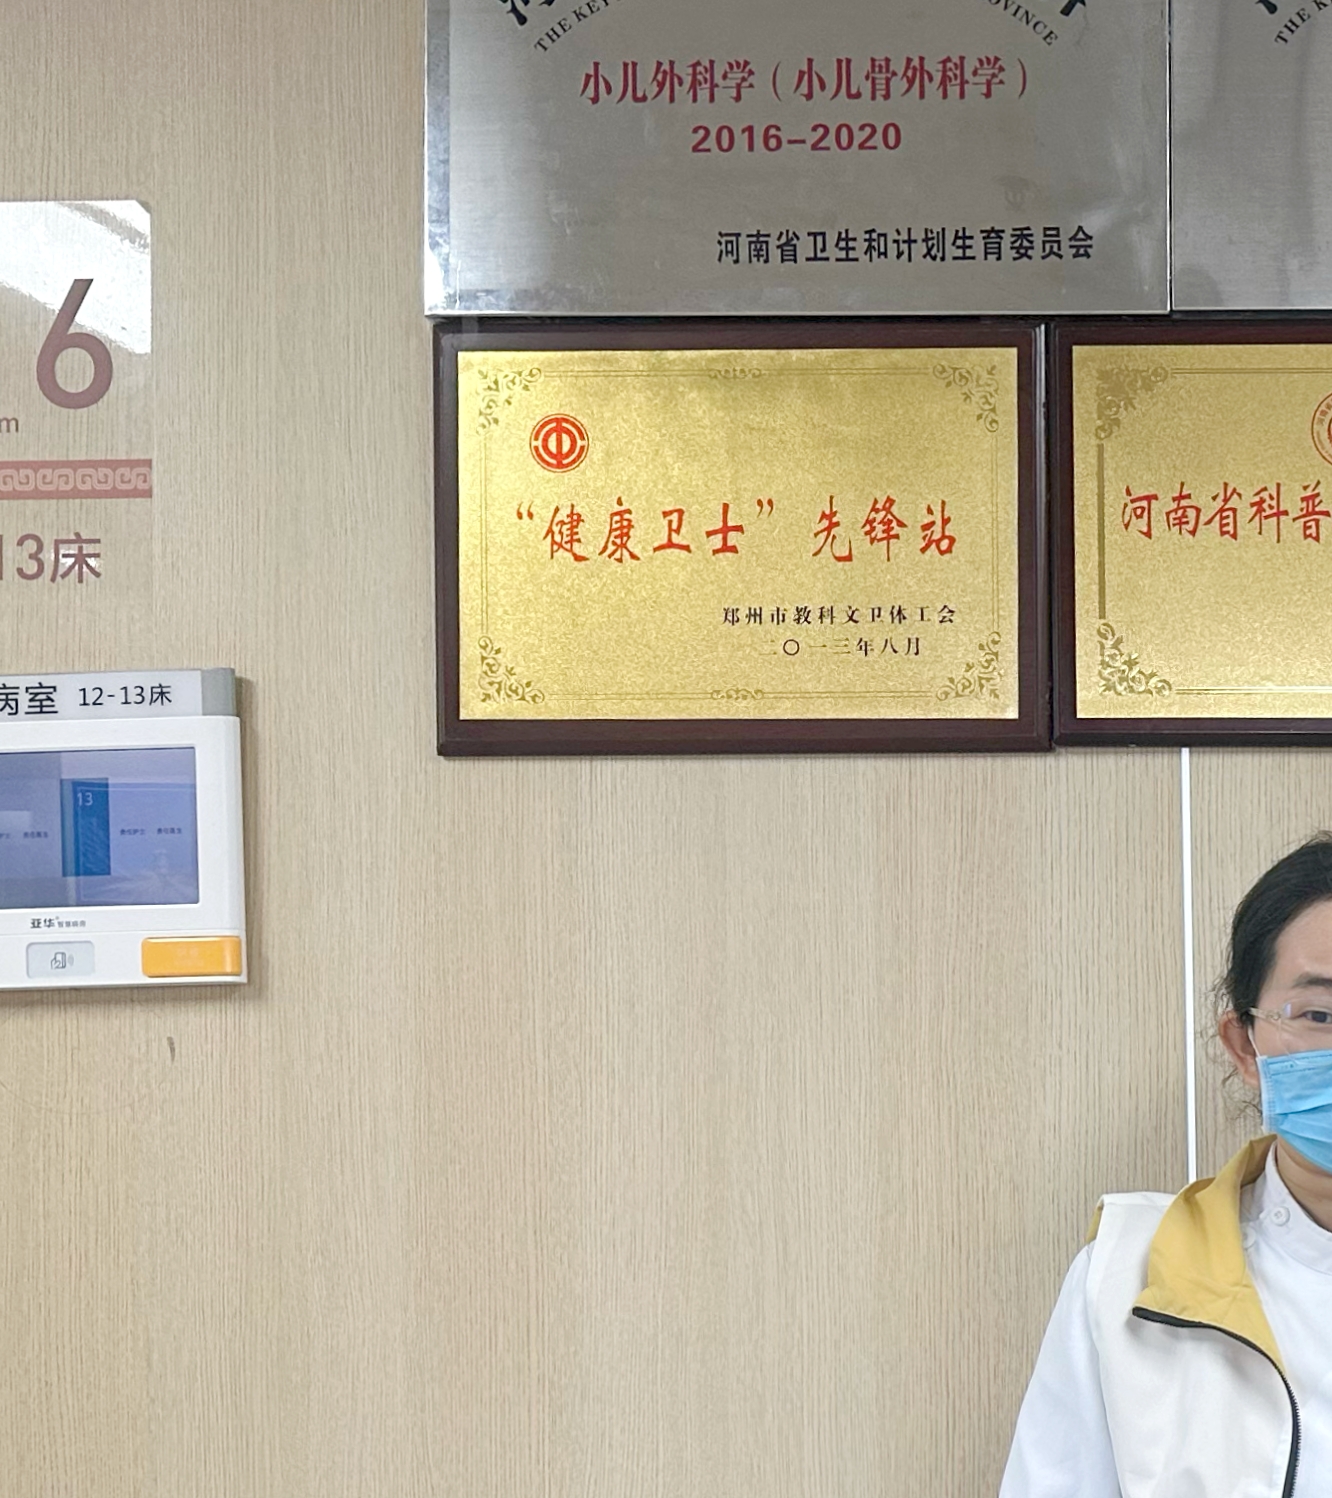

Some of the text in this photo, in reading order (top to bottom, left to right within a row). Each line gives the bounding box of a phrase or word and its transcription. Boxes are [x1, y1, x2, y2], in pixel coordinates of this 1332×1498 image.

[534, 17, 572, 52] THE
[1274, 8, 1311, 45] THE
[690, 122, 902, 154] 2016-2020
[716, 225, 1095, 264] 河南省卫生和计划生育委员会
[36, 278, 113, 410] 6
[722, 604, 957, 625] 郑州市教科文卫体工会
[78, 683, 173, 707] 12-13床
[76, 791, 94, 807] 13
